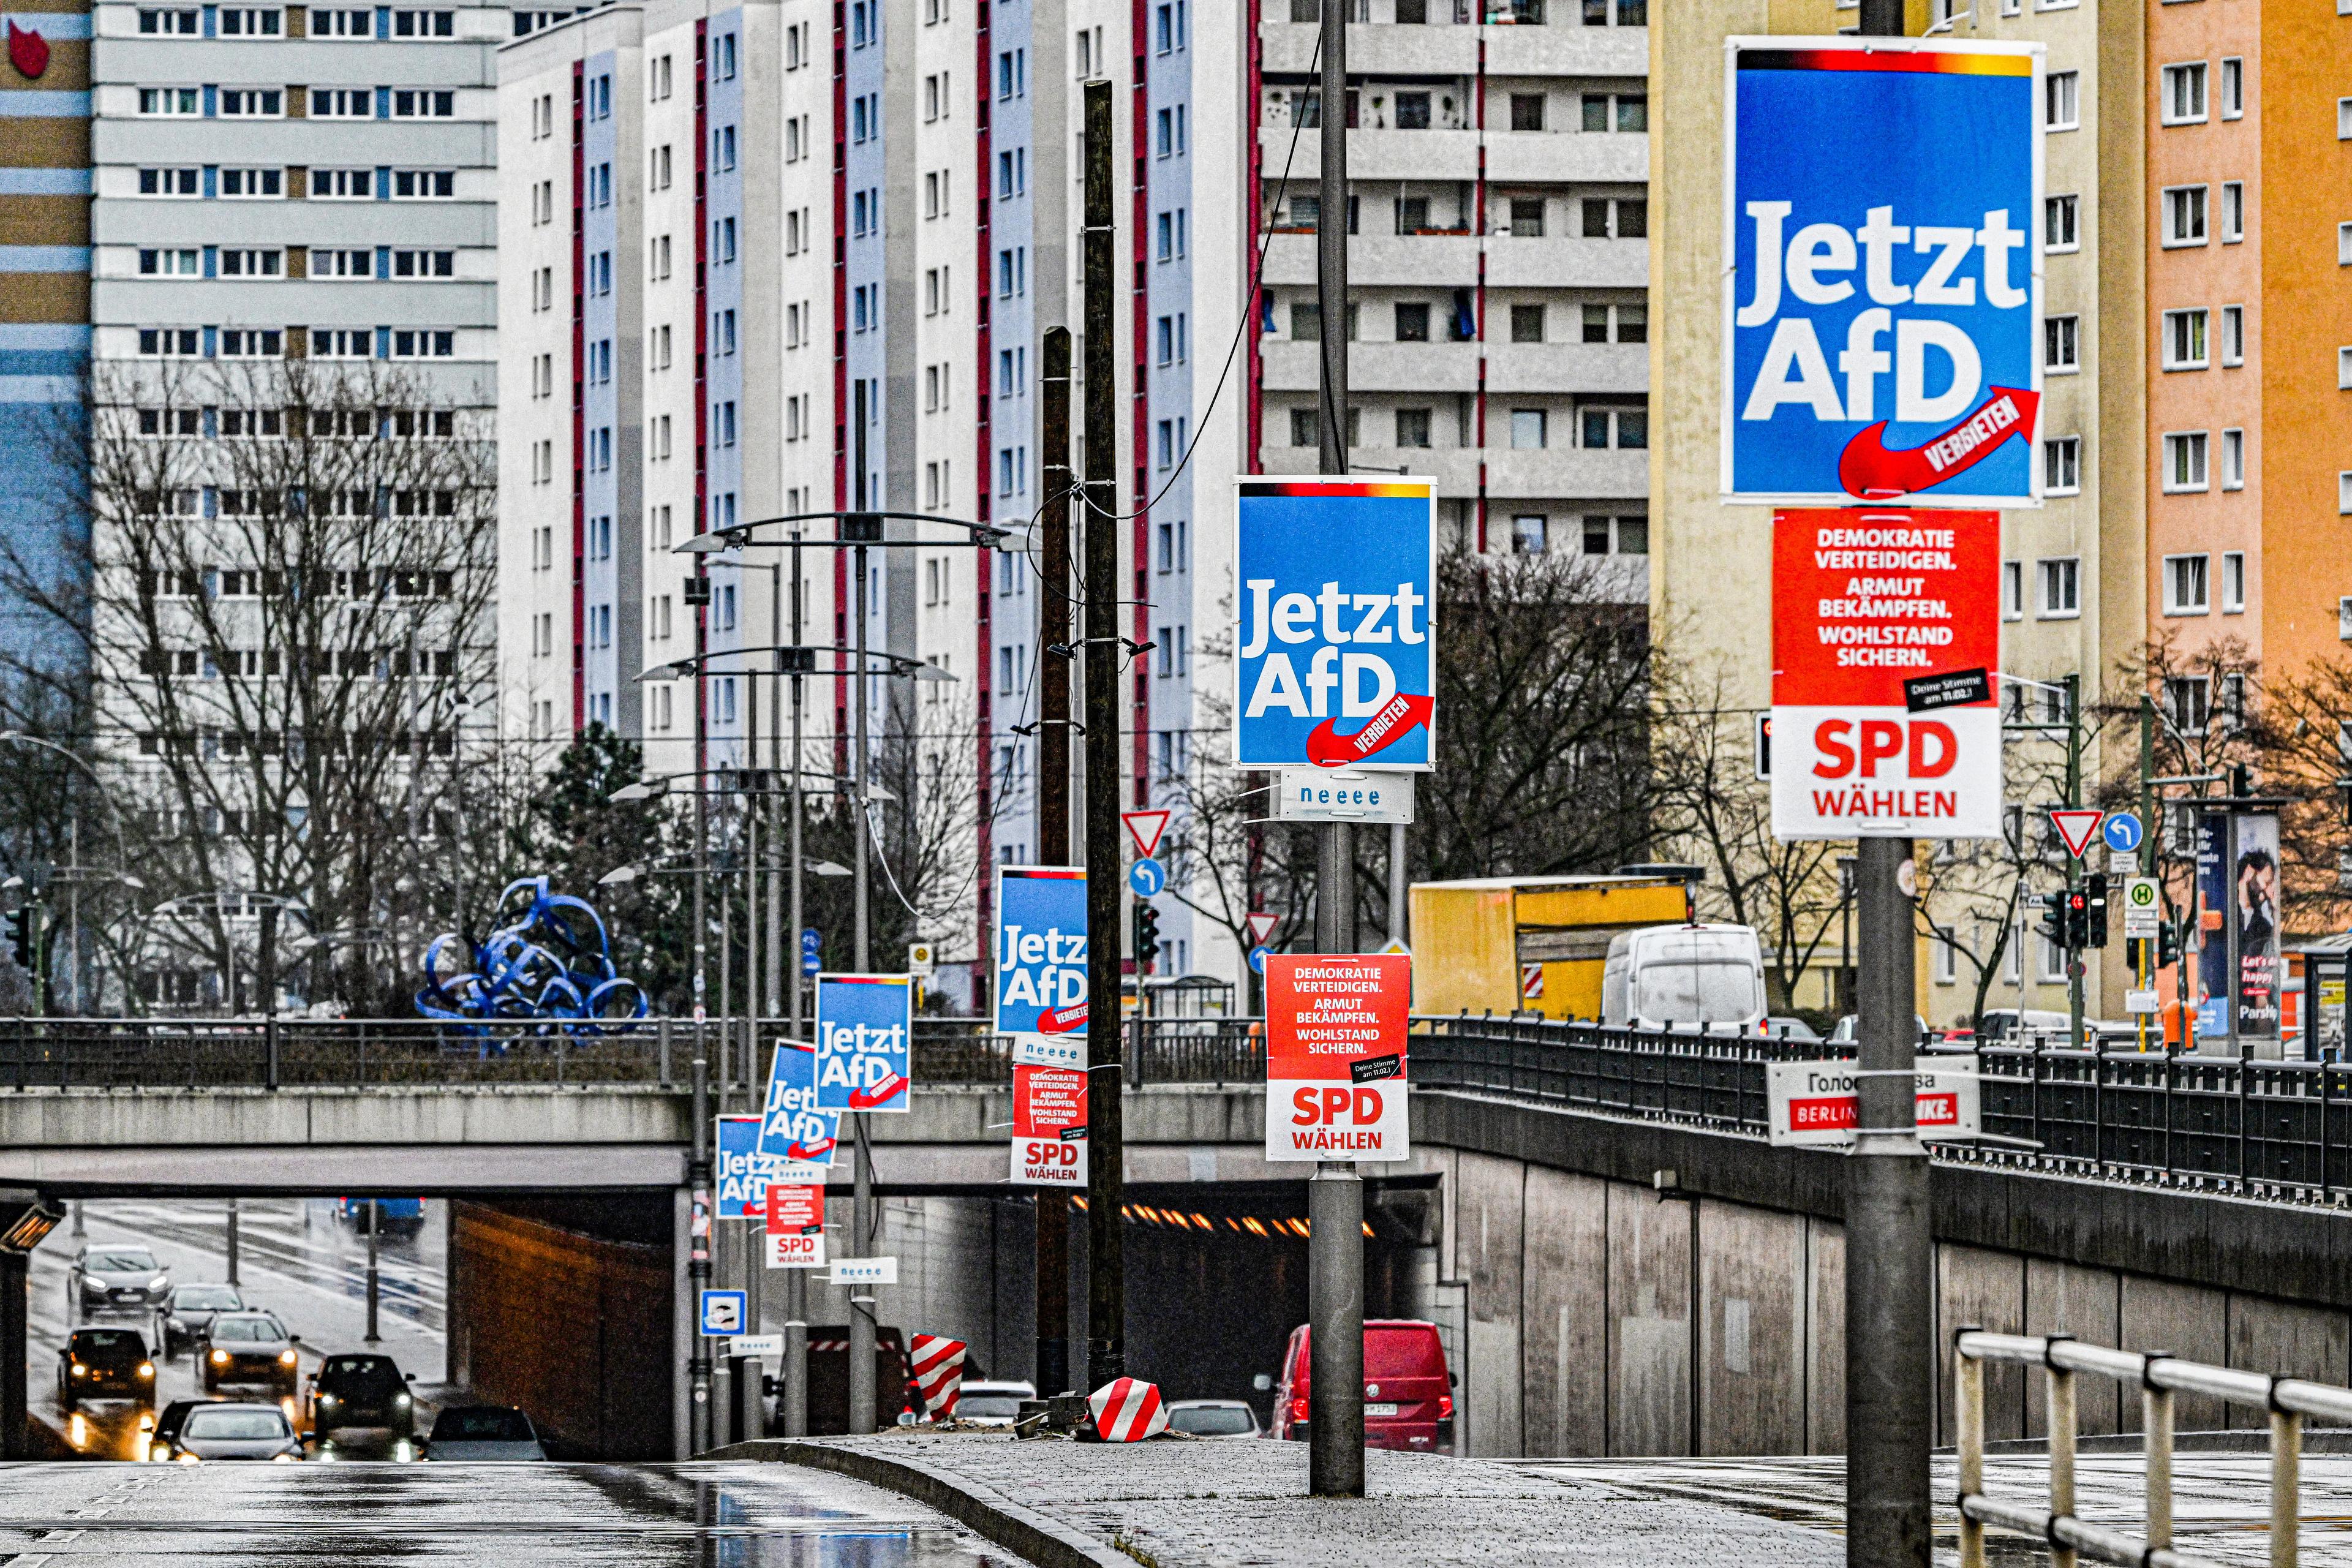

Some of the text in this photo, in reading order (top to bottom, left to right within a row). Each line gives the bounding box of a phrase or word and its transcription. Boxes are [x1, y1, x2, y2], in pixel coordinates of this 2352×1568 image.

[1737, 201, 2027, 327] Jetzt
[1741, 308, 1982, 423] AfD
[1923, 394, 2021, 473] VERBIETEN
[1817, 529, 1954, 548] DEMOKRATIE
[1815, 551, 1956, 570] VERTEIDIGEN.
[1846, 578, 1924, 596] ARMUT
[1819, 595, 1952, 618] BEKÄMPFEN.
[1241, 579, 1425, 658] Jetzt
[1817, 626, 1953, 645] WOHLSTAND
[1837, 648, 1932, 666] SICHERN.
[1245, 646, 1396, 717] AfD
[1353, 696, 1410, 753] VERBIETEN
[1812, 719, 1958, 779] SPD
[1813, 785, 1956, 817] WÄHLEN
[1001, 925, 1087, 971] Jetz
[1295, 967, 1381, 979] DEMOKRATIE
[1002, 965, 1088, 1006] AfD
[1294, 981, 1382, 993] VERTEIDIGEN.
[1314, 998, 1362, 1009] ARMUT
[1055, 1006, 1088, 1025] VERBIETE
[1296, 1009, 1379, 1023] BEKÄMPFEN.
[819, 1021, 906, 1059] Jetzt
[1296, 1029, 1379, 1041] WOHLSTAND
[1308, 1042, 1367, 1054] SICHERN.
[820, 1053, 891, 1087] AfD
[1373, 1060, 1396, 1069] Stimme
[1029, 1081, 1079, 1090] VERTEIDIGEN.
[1030, 1073, 1079, 1082] DEMOKRATIE
[769, 1080, 837, 1117] Jet
[1030, 1098, 1077, 1107] BEKÄMPFEN.
[1291, 1087, 1383, 1126] SPD
[1030, 1109, 1077, 1117] WOHLSTAND
[1797, 1104, 1858, 1123] BERLIN
[766, 1110, 826, 1143] AfD
[1291, 1128, 1382, 1149] WÄHLEN
[1025, 1142, 1077, 1166] SPD
[1025, 1167, 1077, 1180] WÄHLEN
[778, 1238, 814, 1253] SPD
